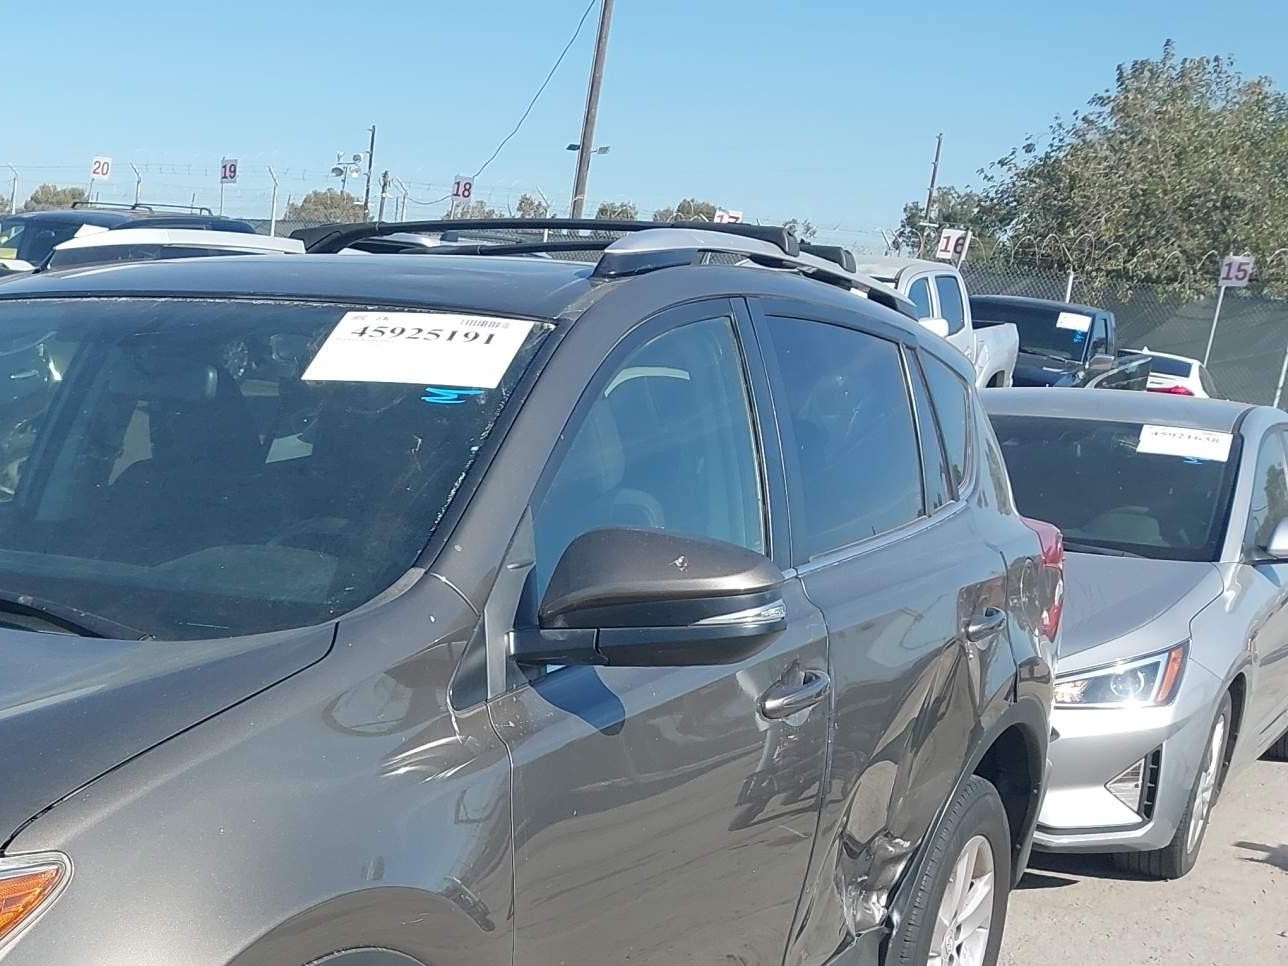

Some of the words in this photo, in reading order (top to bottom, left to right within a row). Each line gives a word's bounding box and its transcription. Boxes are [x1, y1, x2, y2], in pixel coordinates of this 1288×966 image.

[92, 160, 110, 176] 20
[221, 163, 237, 179] 19
[452, 181, 472, 198] 18
[939, 235, 966, 254] 16
[1222, 262, 1250, 281] 15
[351, 324, 495, 345] 45925191
